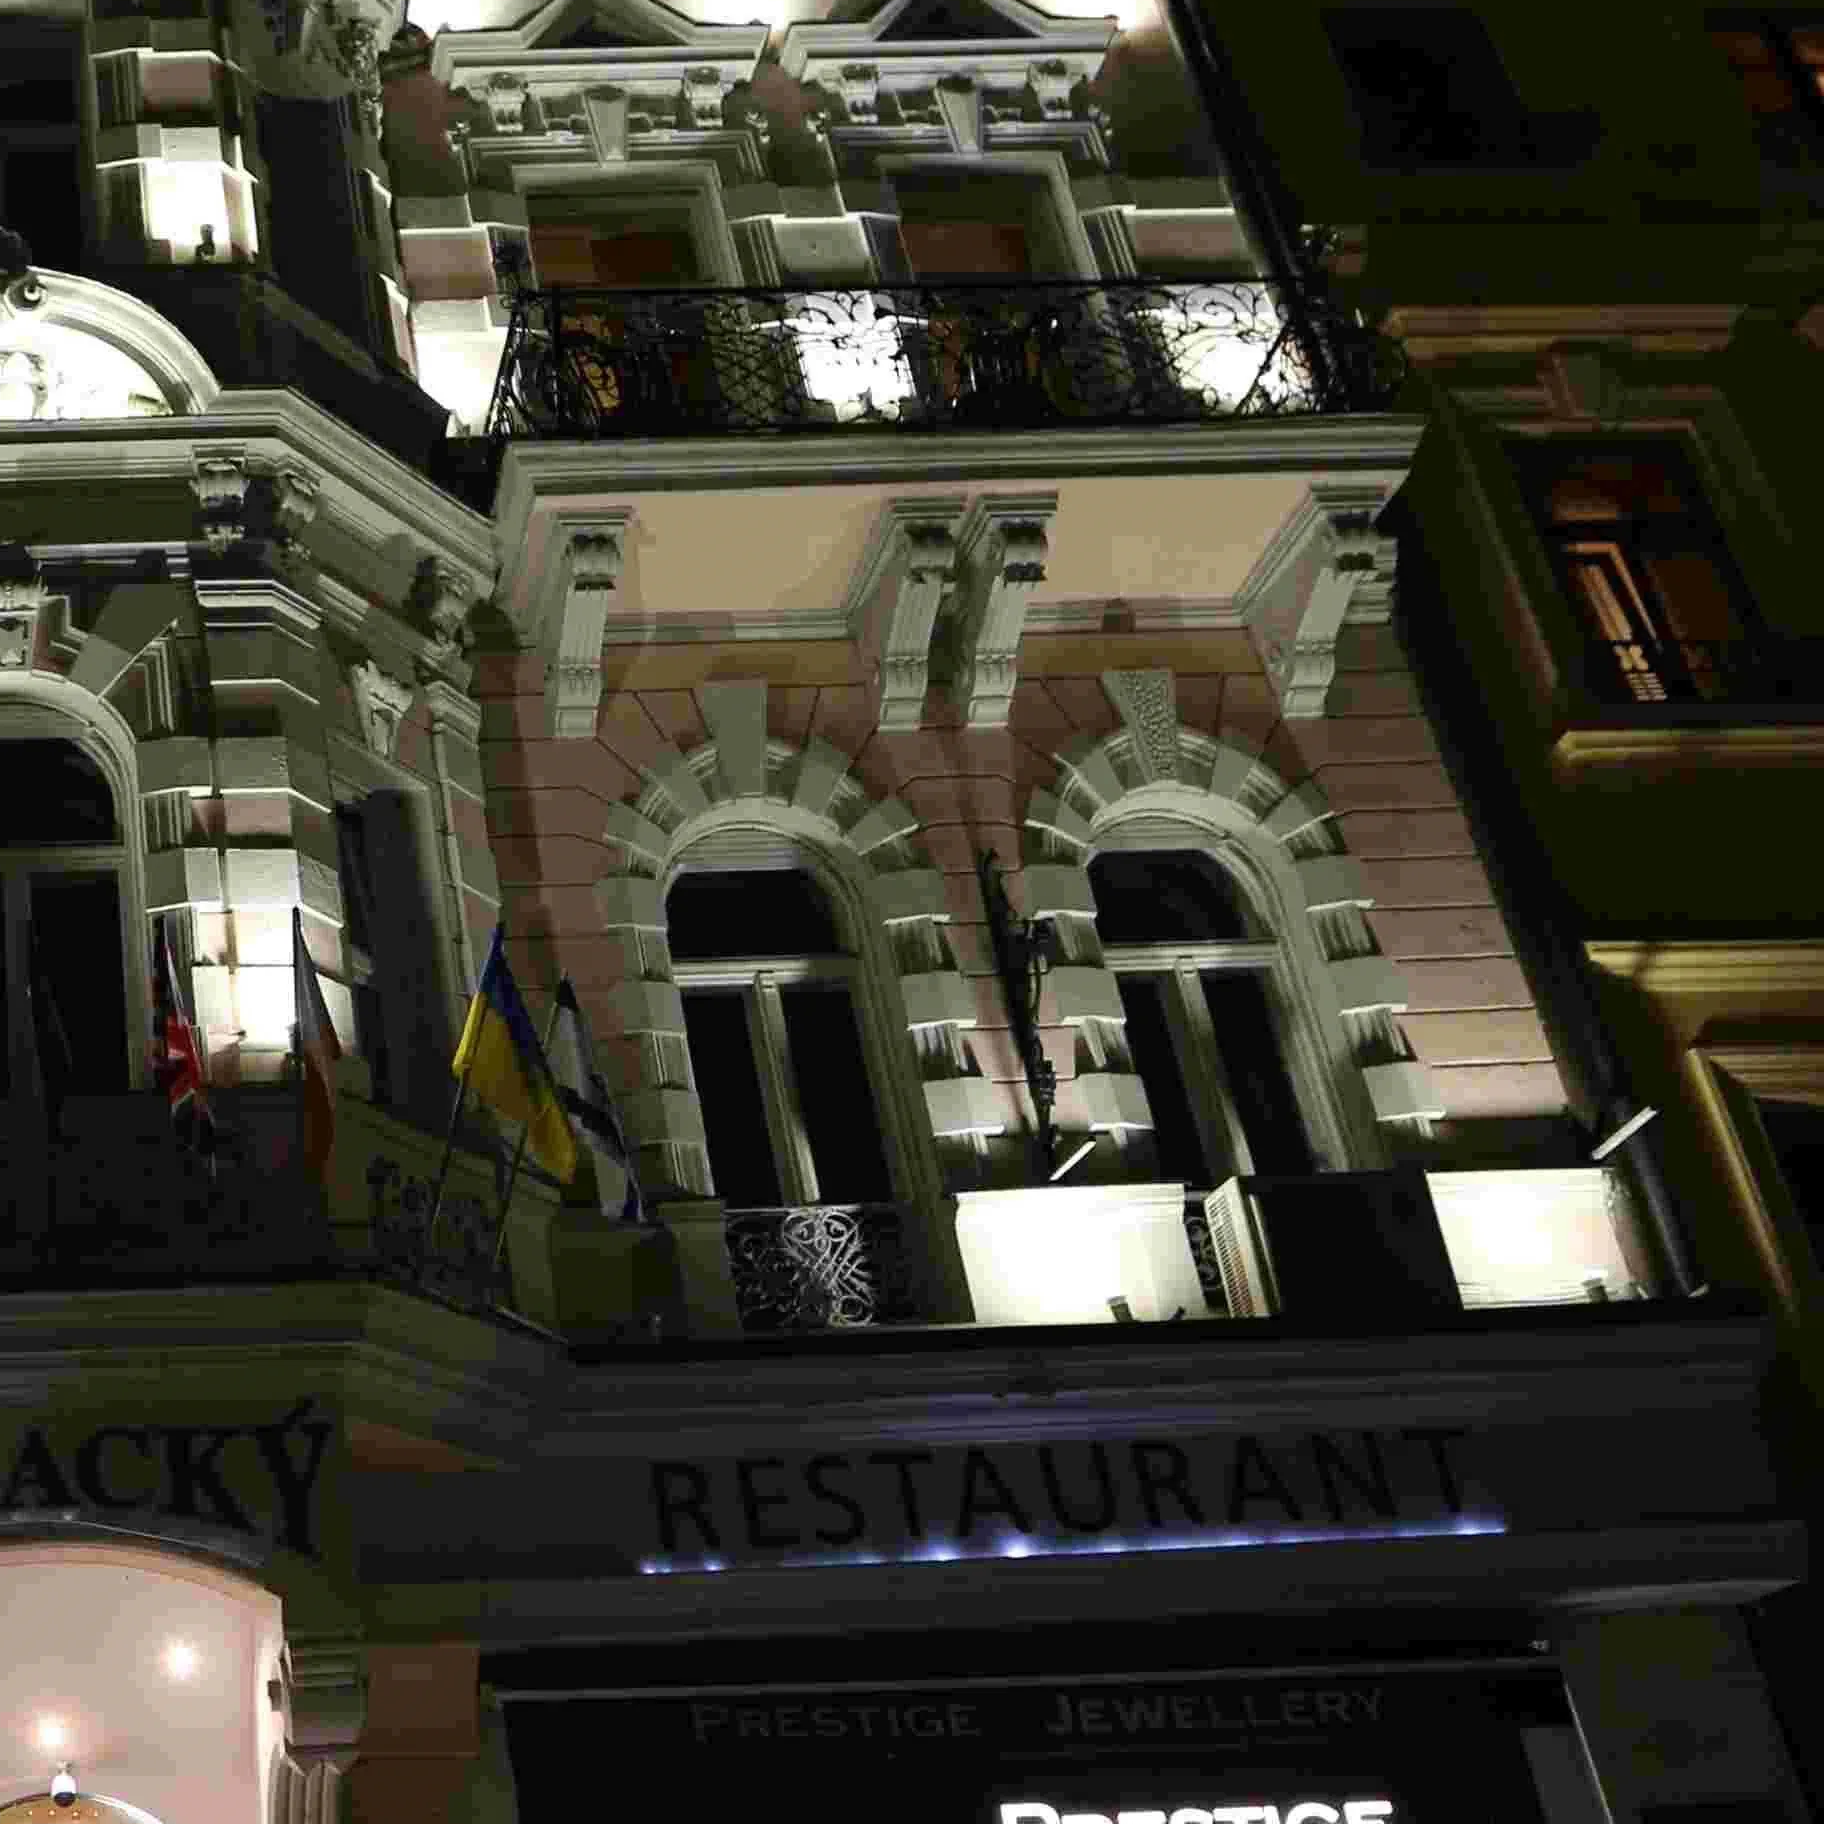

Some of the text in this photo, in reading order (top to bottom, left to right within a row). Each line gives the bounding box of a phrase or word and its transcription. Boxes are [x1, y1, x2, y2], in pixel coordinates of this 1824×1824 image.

[648, 1427, 1465, 1553] RESTAURANT
[689, 1687, 1384, 1744] PRESTIGE JEWELLERY
